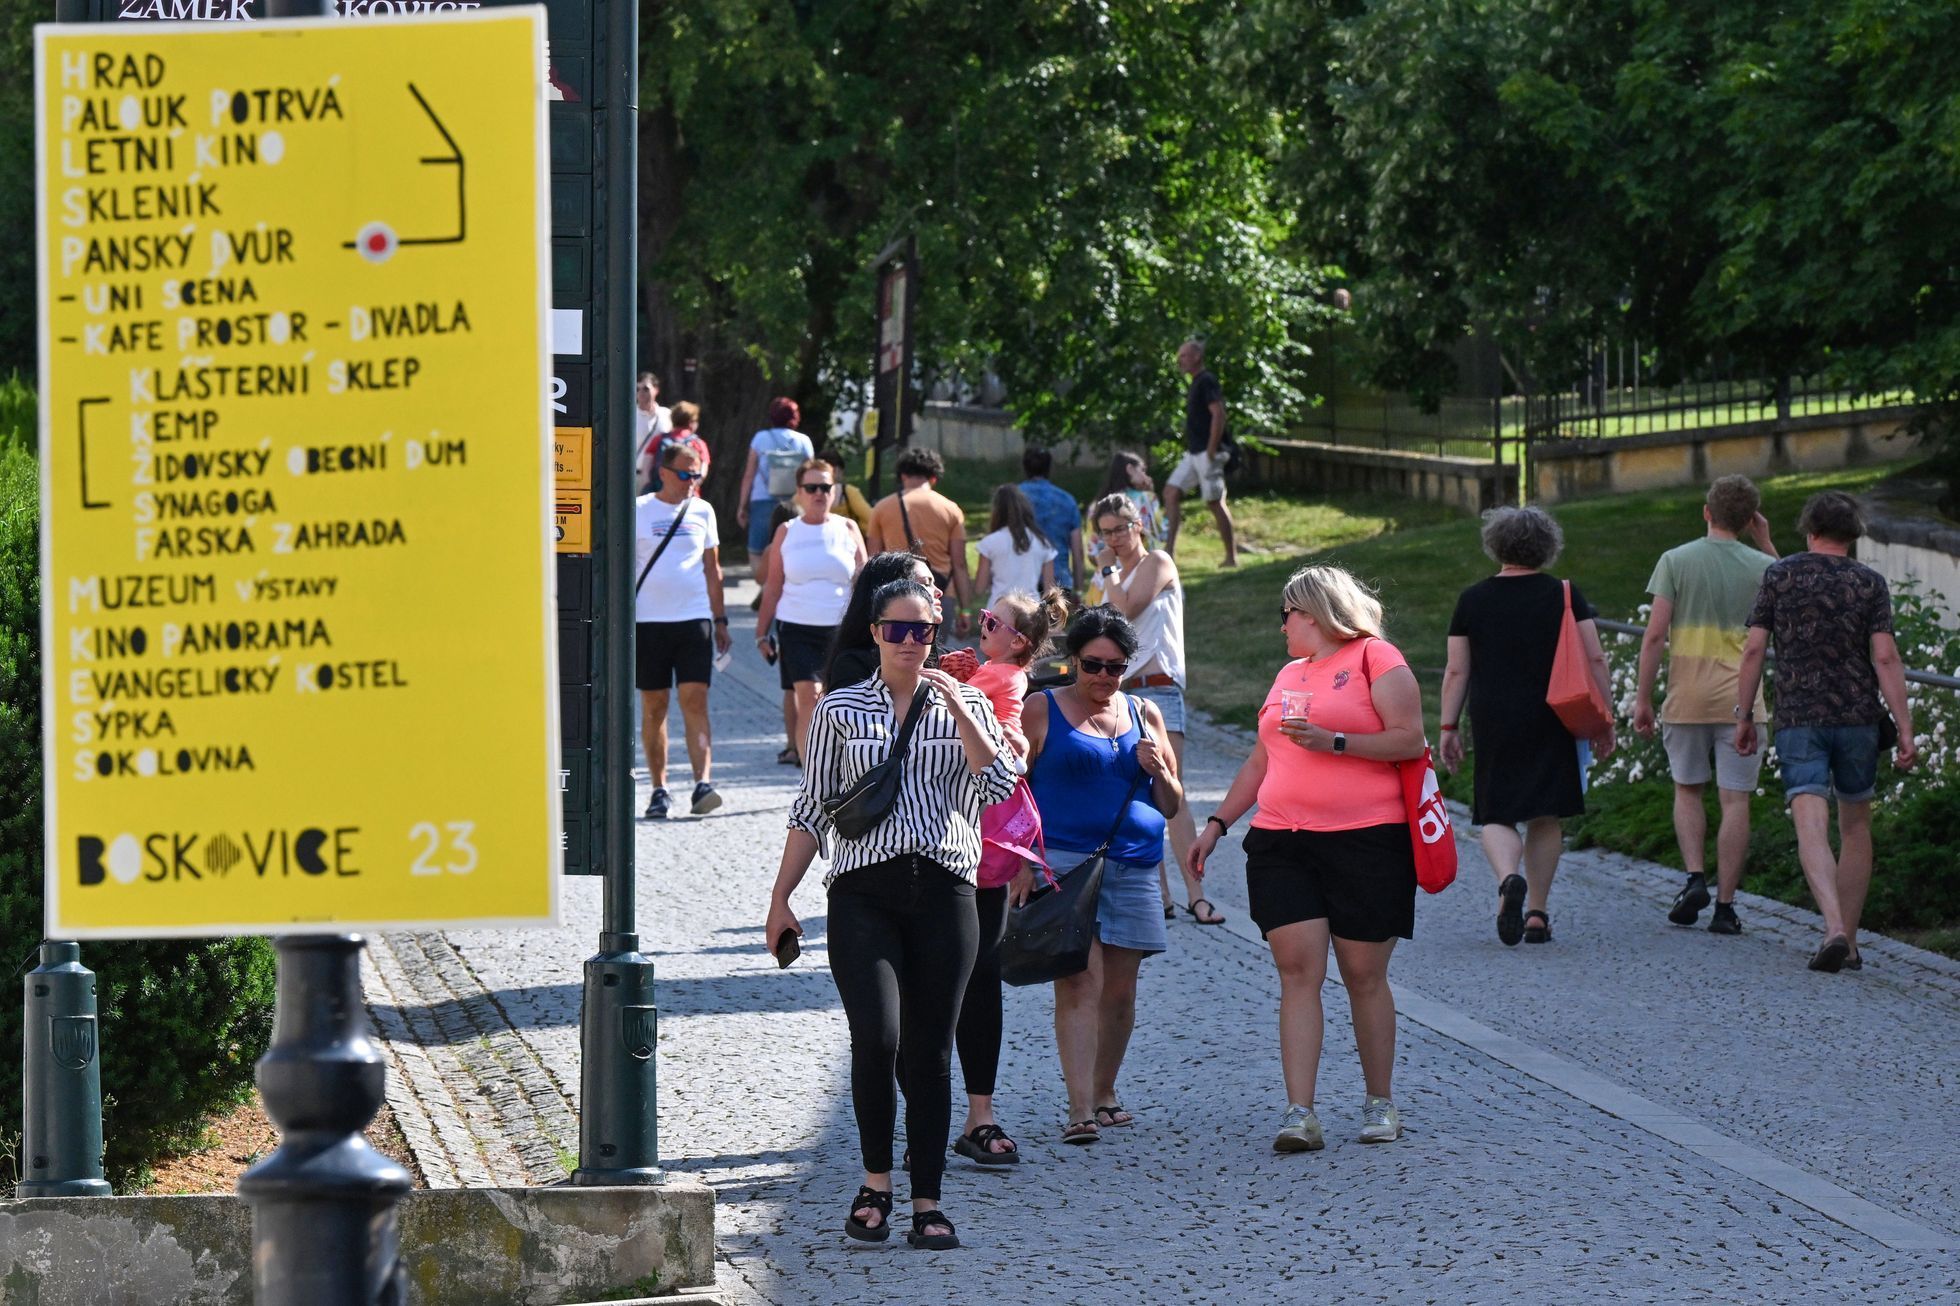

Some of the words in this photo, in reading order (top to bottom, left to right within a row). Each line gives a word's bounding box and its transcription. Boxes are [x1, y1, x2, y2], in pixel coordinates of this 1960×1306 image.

[61, 51, 165, 90] HRAD
[62, 94, 188, 133] PALOUK
[211, 74, 344, 127] POTRVÁ
[61, 127, 184, 178] LETNÍ
[195, 130, 285, 168] KINO
[62, 172, 222, 227] SKLENÍK
[62, 223, 197, 278] PANSKÝ
[211, 221, 295, 268] DVŮR
[84, 283, 143, 315] UNI
[84, 321, 163, 356] KAFE
[177, 311, 307, 352] PROSTOR
[350, 299, 472, 342] DIVADLA
[130, 351, 316, 405] KLÁŠTERNÍ
[327, 356, 421, 395] SKLEP
[130, 409, 219, 446] KEMP
[287, 430, 394, 477] OBECNÍ
[405, 428, 467, 471] DŮM
[133, 488, 277, 524] SYNAGOGA
[135, 517, 258, 562] FARSKÁ
[272, 518, 407, 554] ZAHRADA
[69, 573, 217, 615] MUZEUM
[69, 626, 148, 662] KINO
[162, 617, 333, 658] PANORAMA
[69, 654, 282, 705] EVANGELICKÝ
[295, 660, 409, 694] KOSTEL
[72, 700, 176, 744] SÝPKA
[73, 744, 255, 782] SOKOLOVNA
[77, 826, 361, 886] BOSKOVICE
[408, 820, 480, 877] 23
